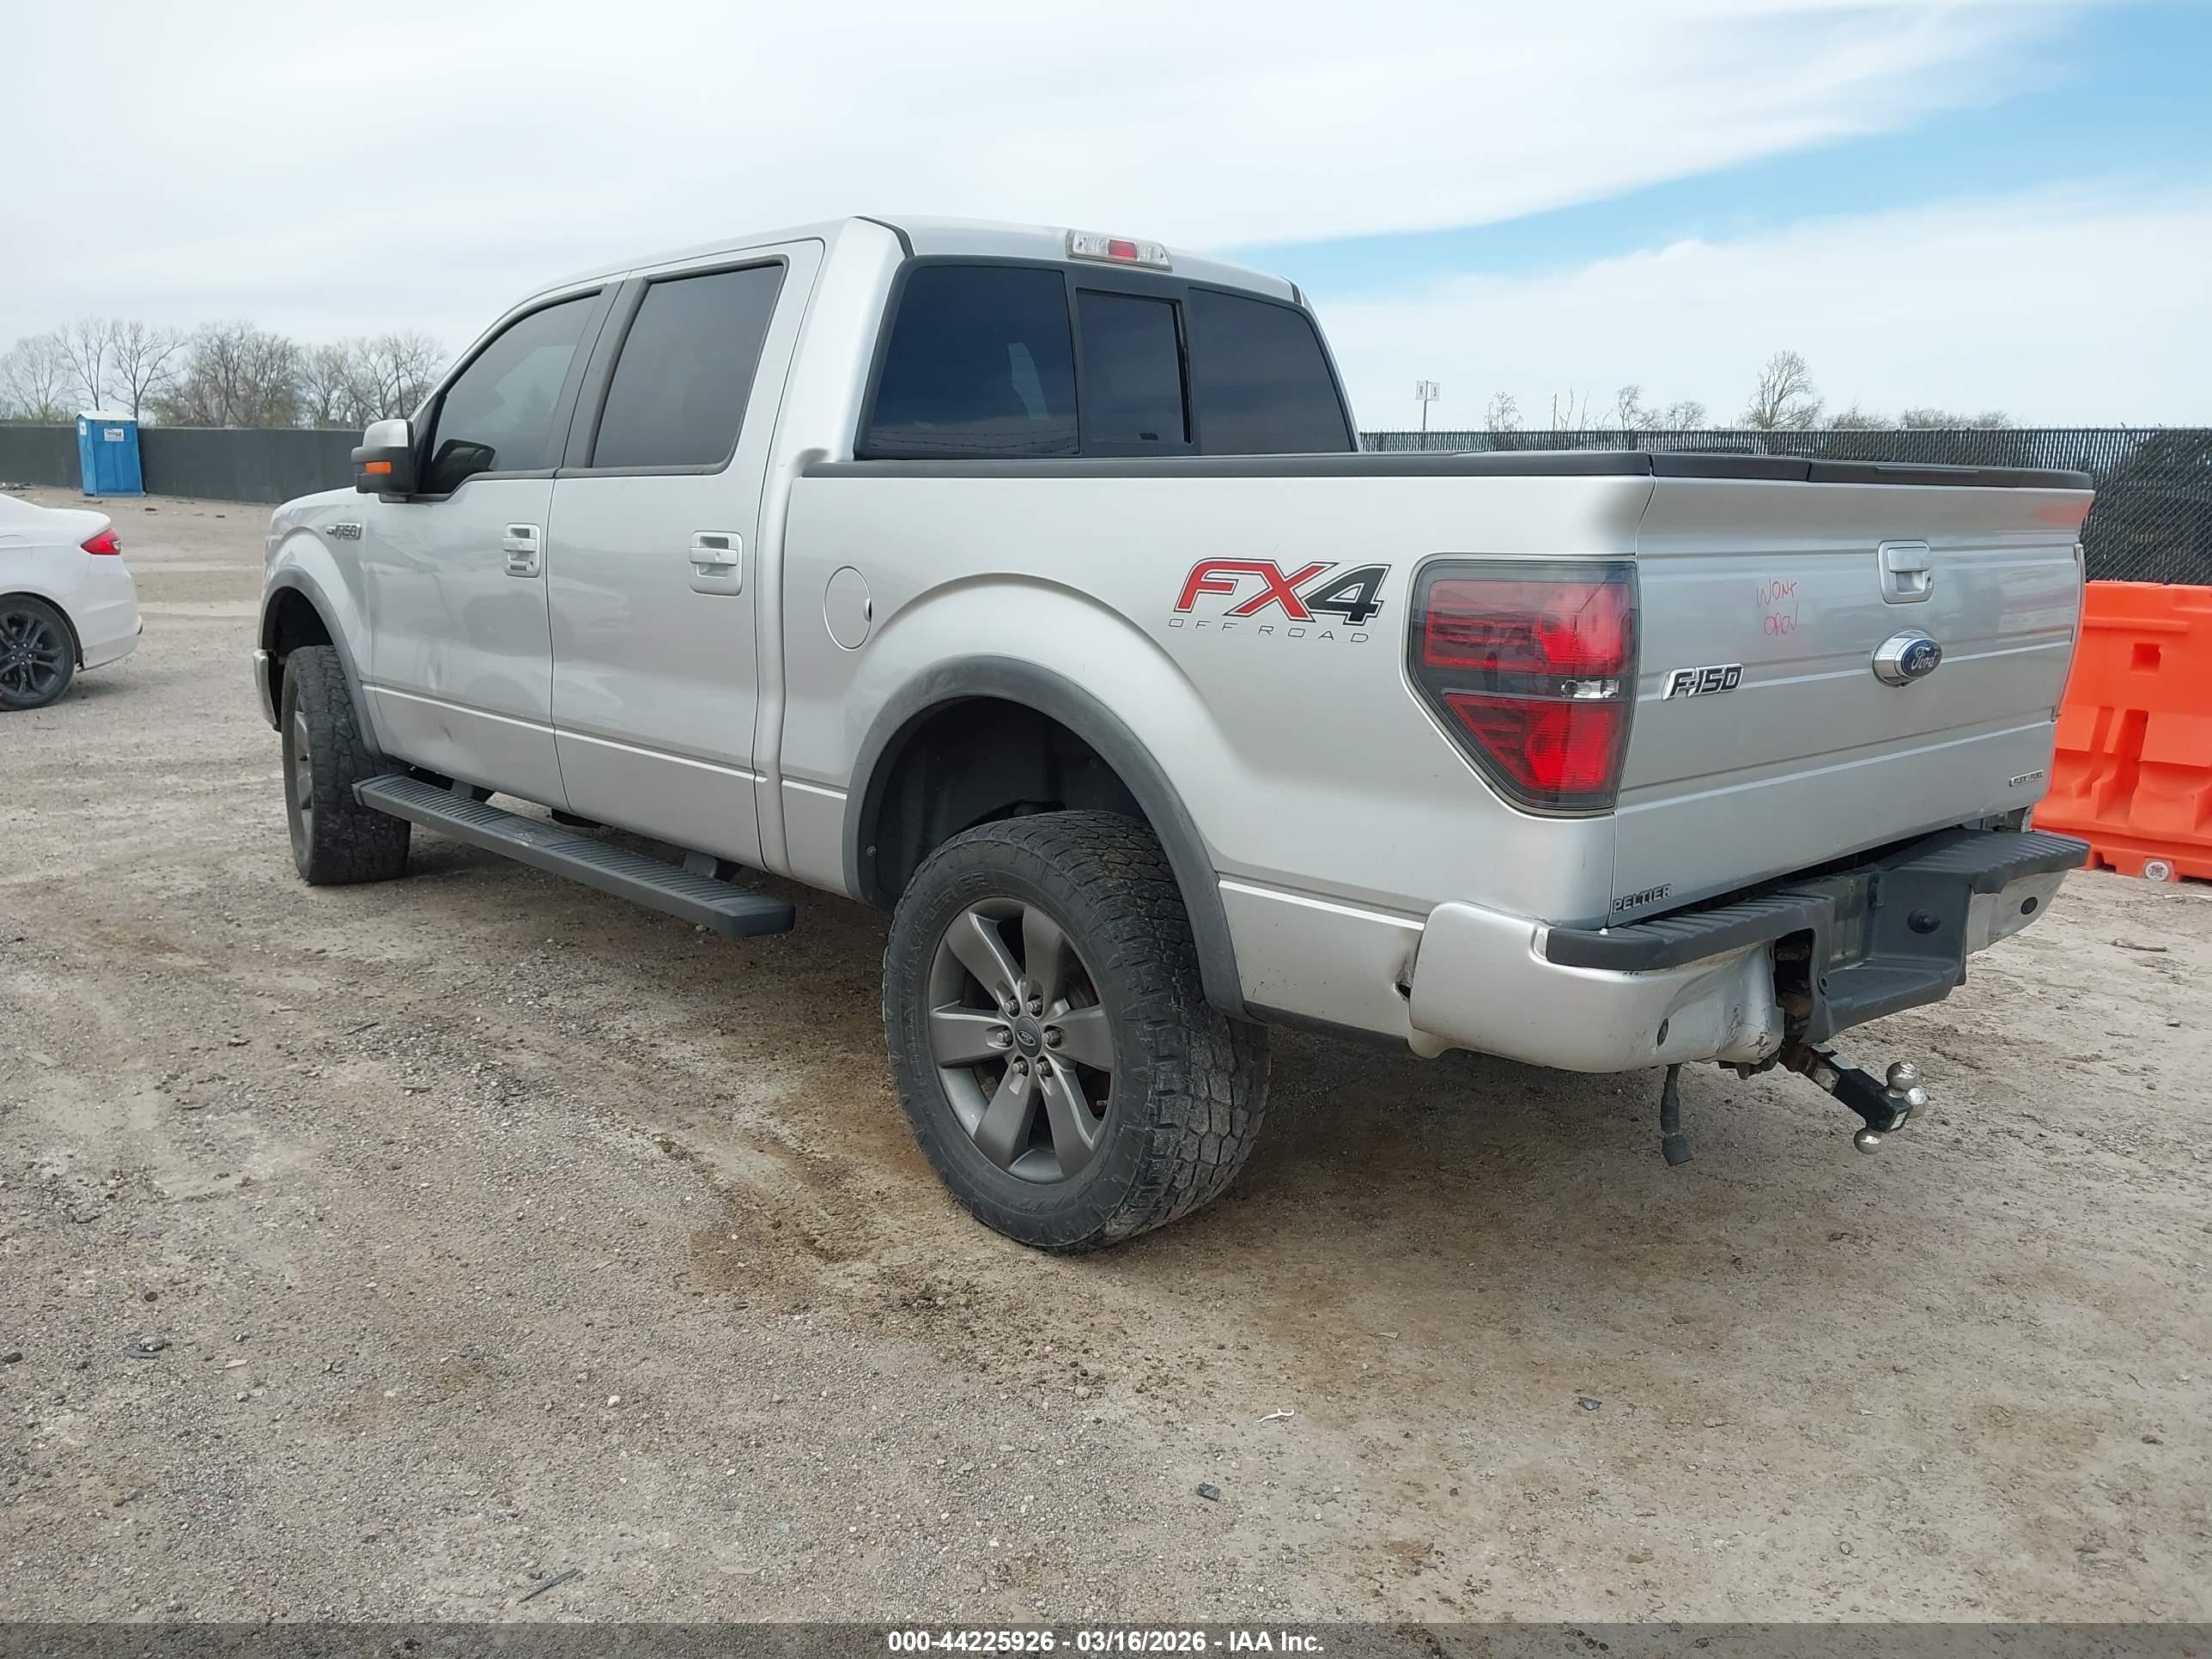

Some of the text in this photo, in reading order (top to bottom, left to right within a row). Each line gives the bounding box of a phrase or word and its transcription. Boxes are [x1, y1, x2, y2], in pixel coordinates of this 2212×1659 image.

[1173, 557, 1392, 626] FX4
[1168, 618, 1370, 643] OFF ROAD
[1911, 644, 1939, 670] Ford
[1662, 663, 1744, 701] F-150
[1613, 883, 1673, 914] PELTIER
